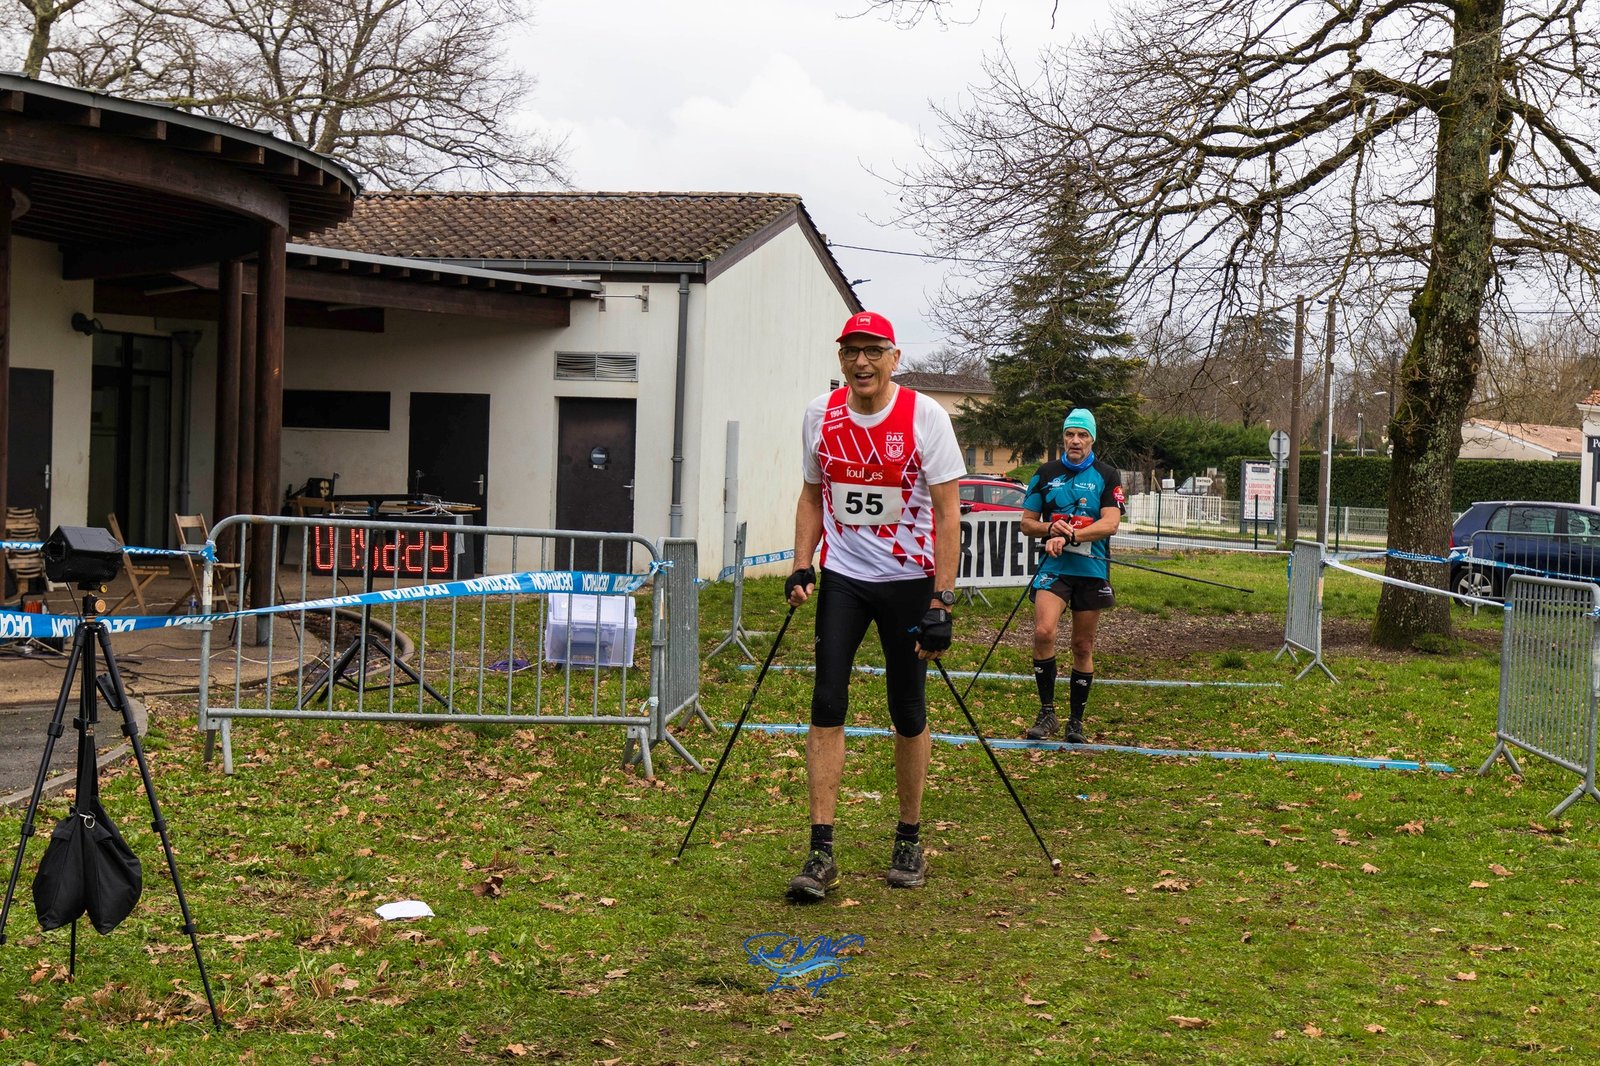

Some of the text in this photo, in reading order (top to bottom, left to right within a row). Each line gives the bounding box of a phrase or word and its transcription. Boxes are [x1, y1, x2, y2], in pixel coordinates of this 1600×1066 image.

[885, 434, 904, 442] DAX
[845, 491, 884, 516] 55
[463, 574, 522, 592] DECATHLON
[529, 571, 574, 591] DECATHLON
[582, 573, 610, 592] DECATHLON
